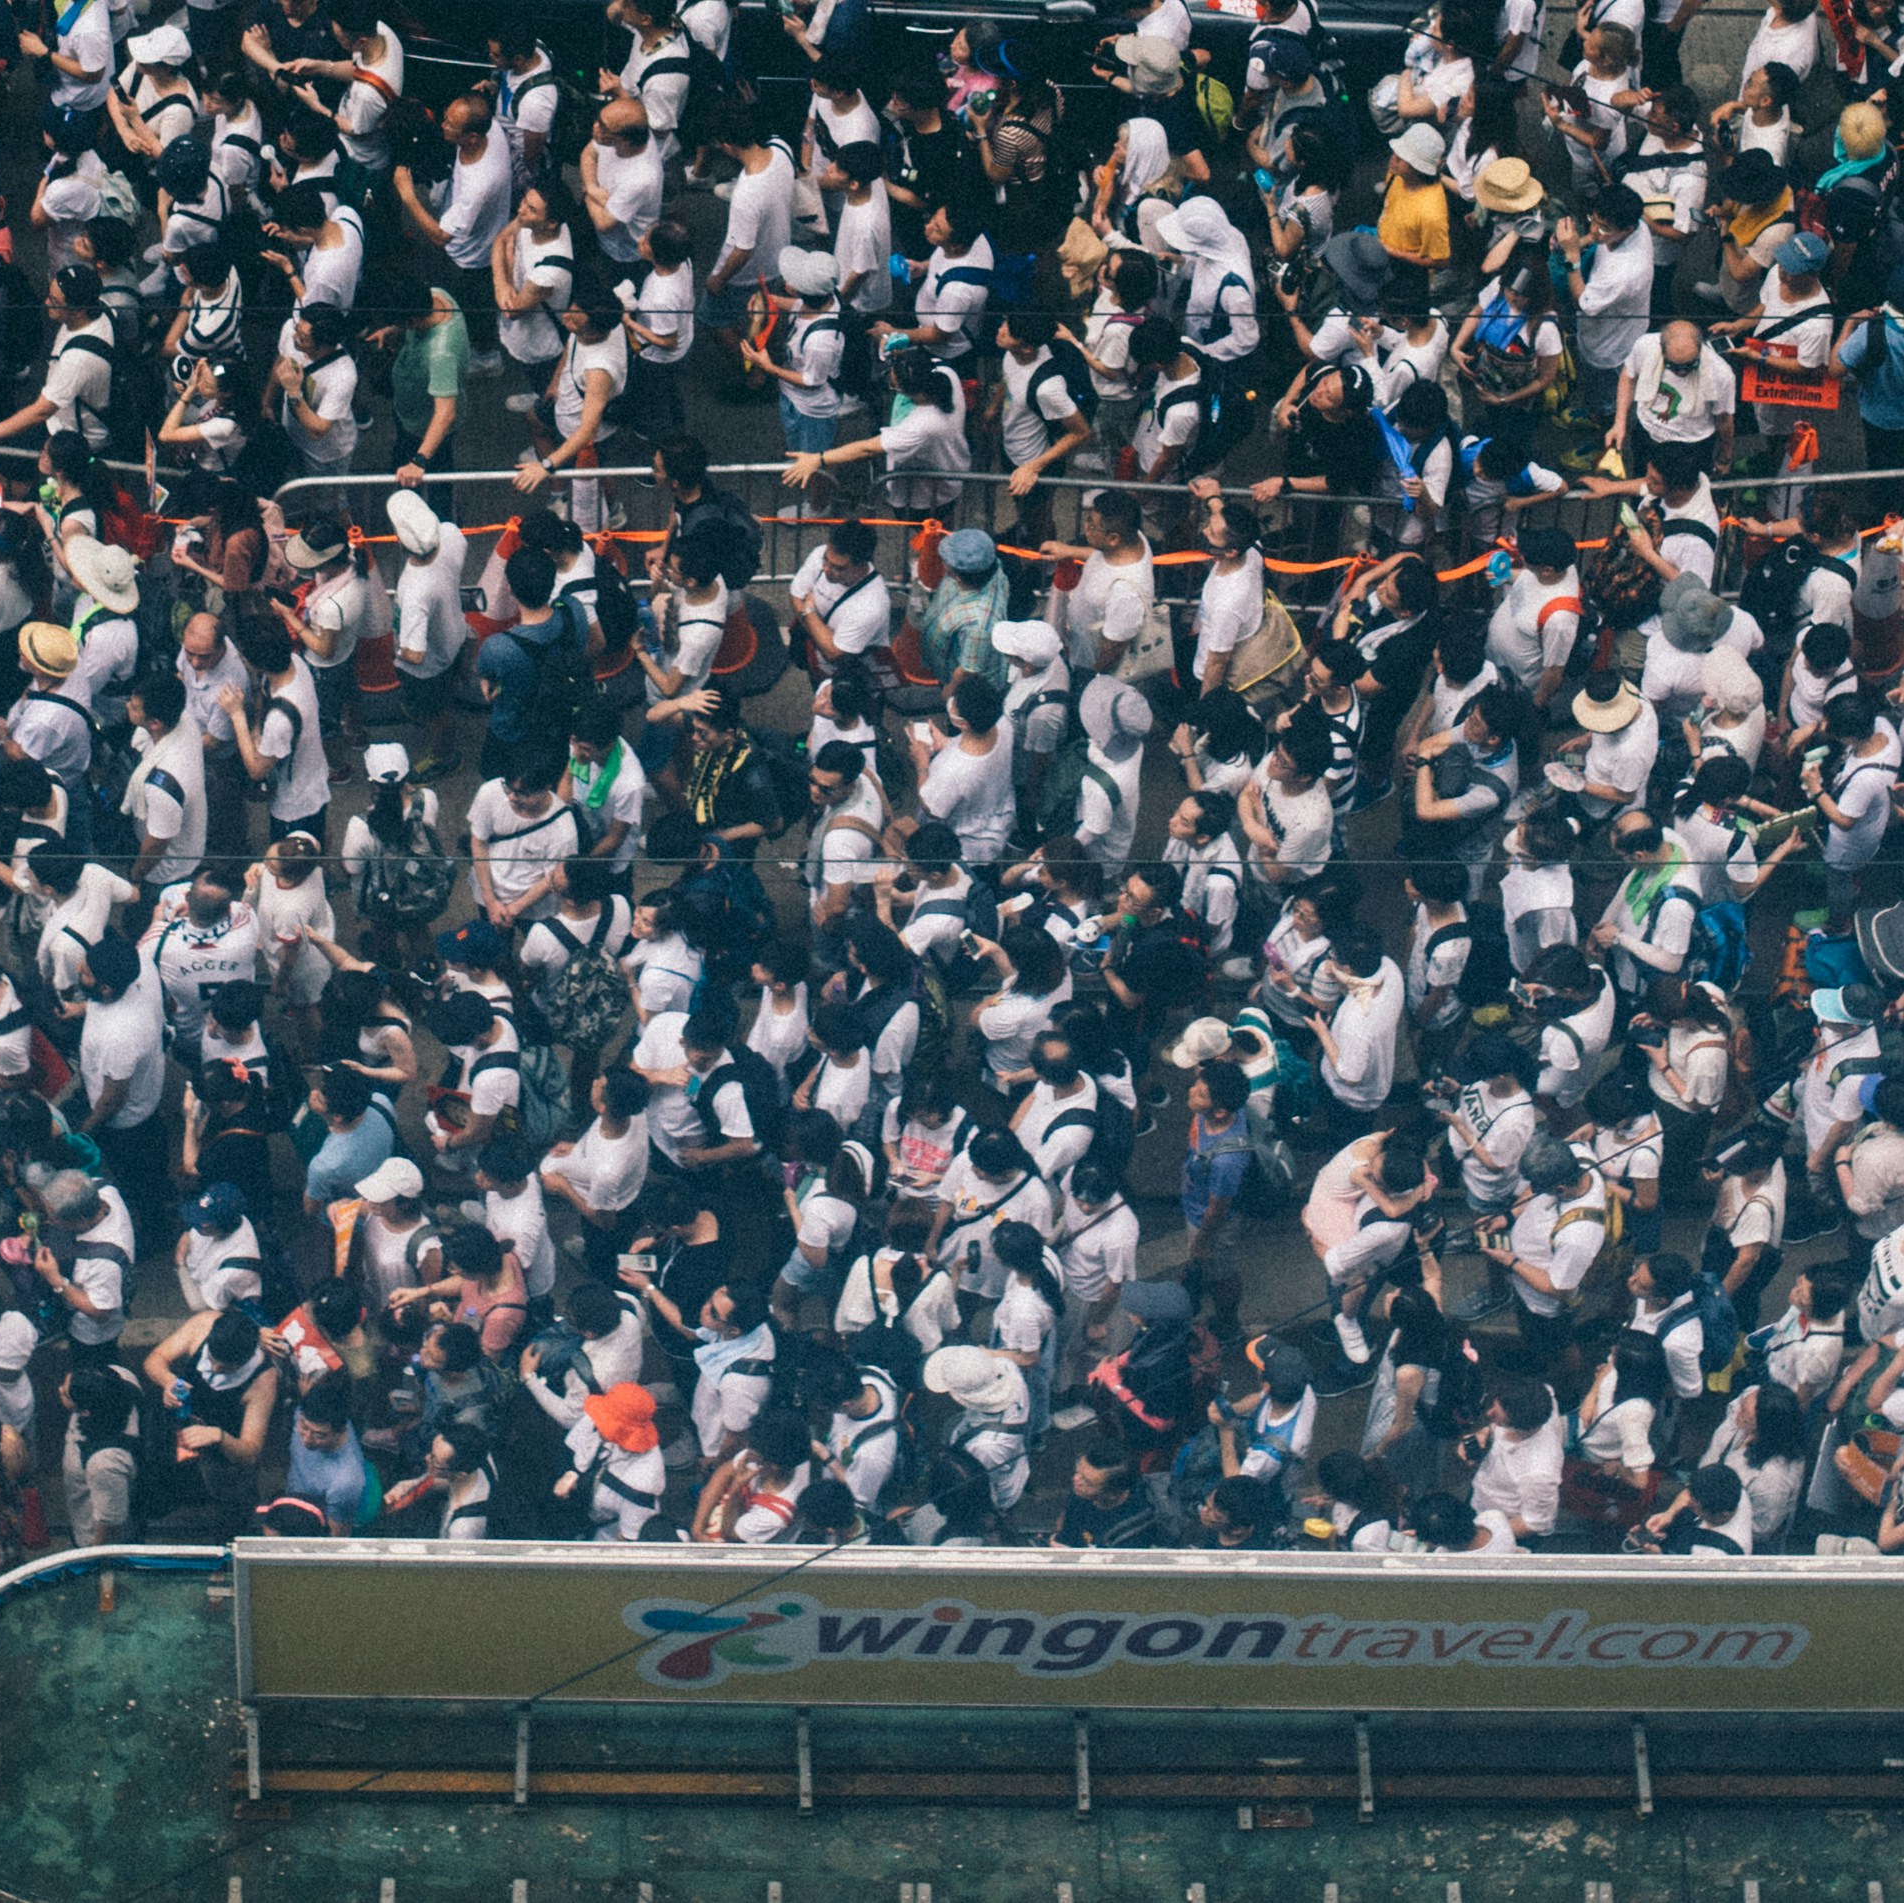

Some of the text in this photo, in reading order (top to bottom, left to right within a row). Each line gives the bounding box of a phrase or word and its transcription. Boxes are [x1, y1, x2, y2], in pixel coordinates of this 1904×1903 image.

[1754, 383, 1823, 405] Extradition
[179, 961, 240, 976] AGGER
[818, 1606, 1794, 1671] wingontravel.com
